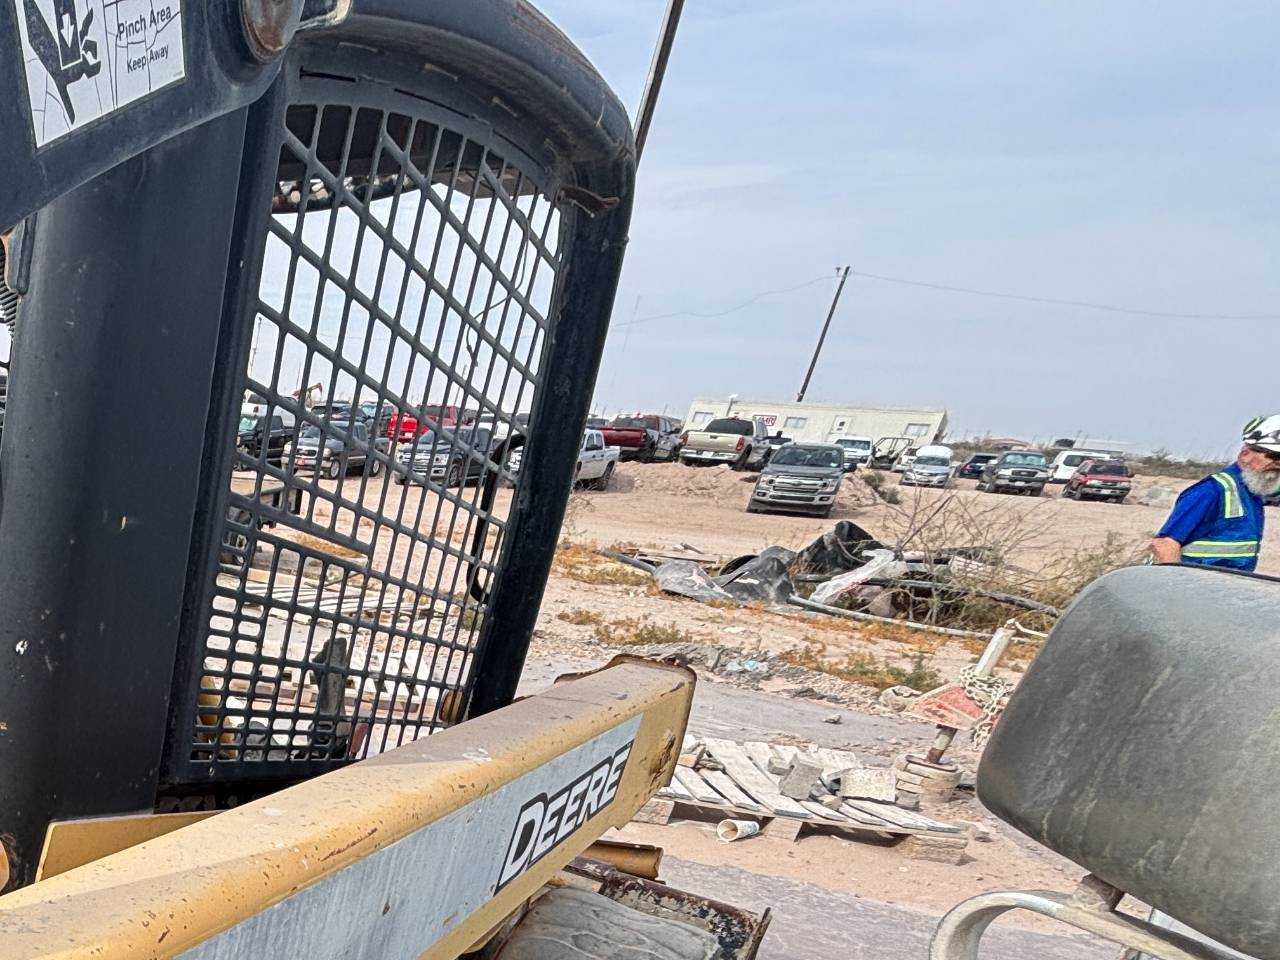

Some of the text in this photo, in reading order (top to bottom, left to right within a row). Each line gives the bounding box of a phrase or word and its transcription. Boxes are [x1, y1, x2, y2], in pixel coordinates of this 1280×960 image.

[118, 6, 171, 41] Pinch Area
[127, 45, 169, 73] Keep Away
[494, 738, 635, 895] DEERE
